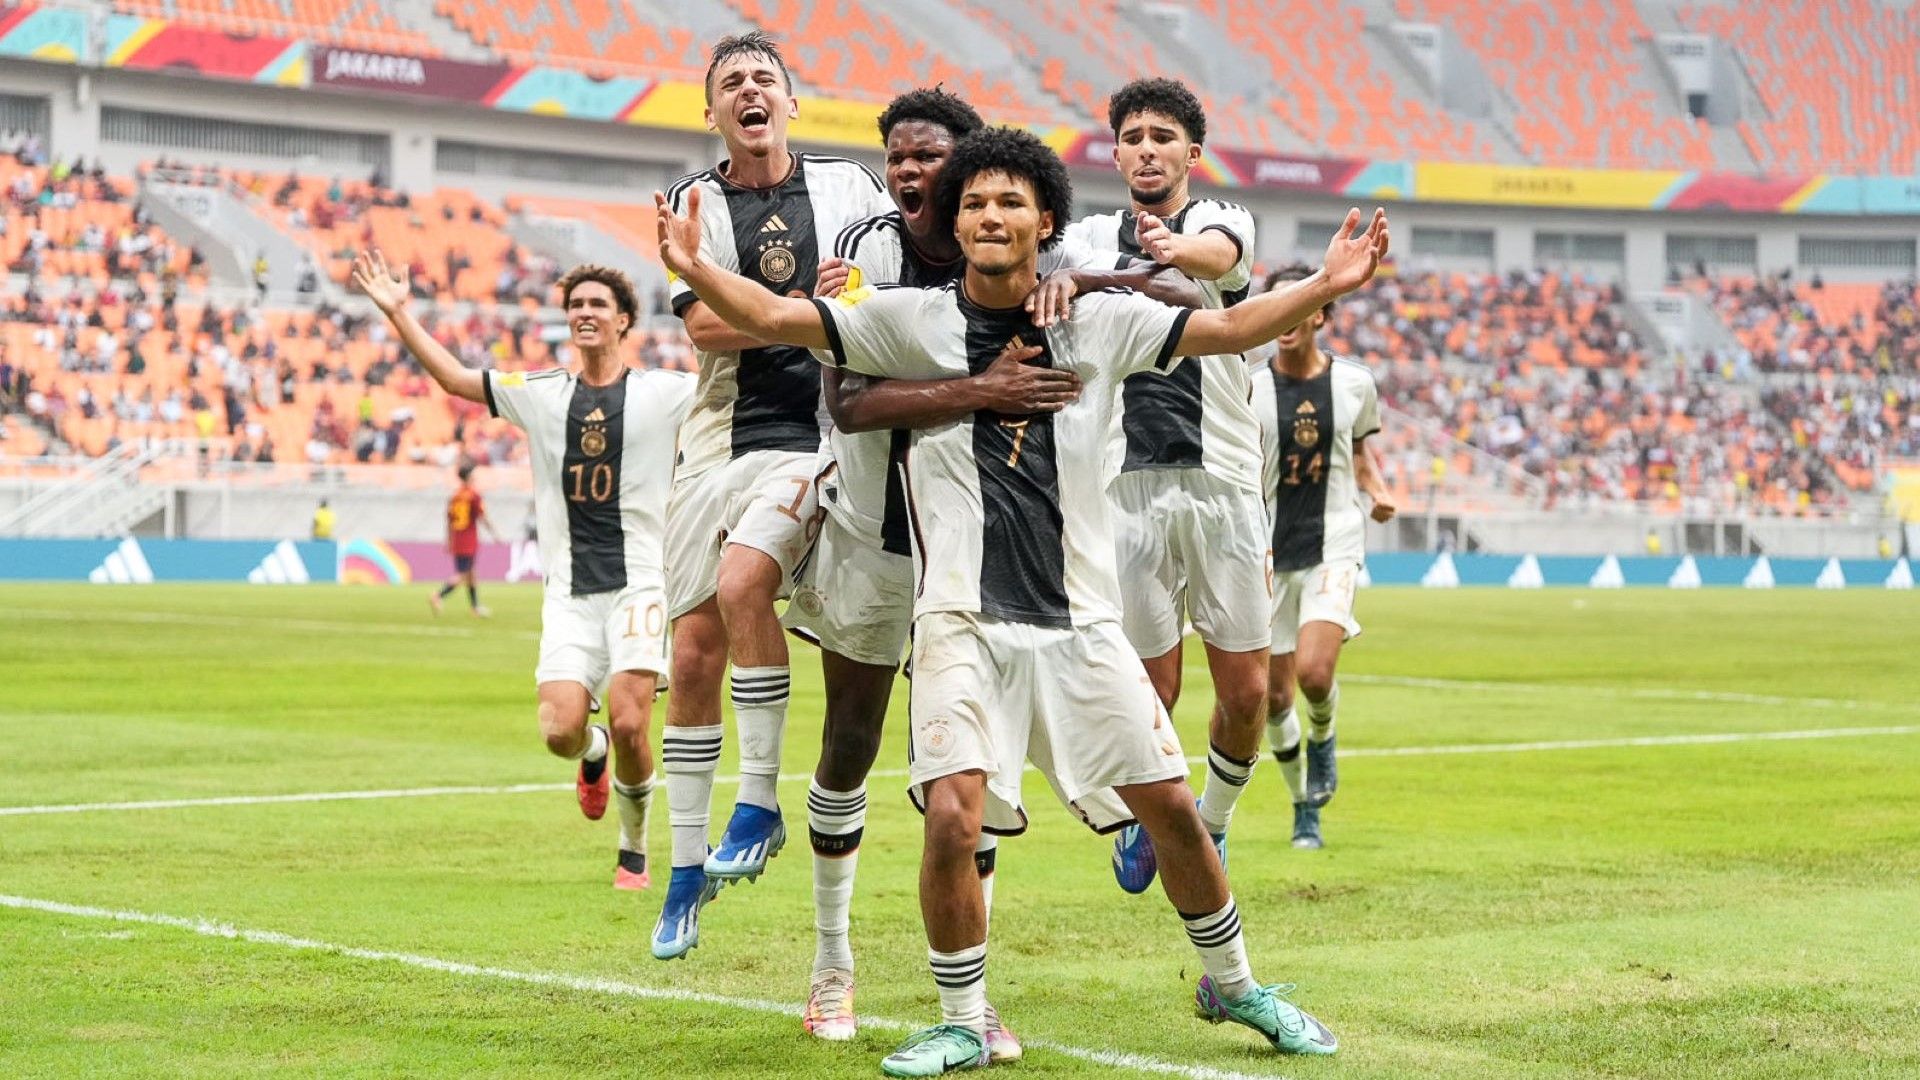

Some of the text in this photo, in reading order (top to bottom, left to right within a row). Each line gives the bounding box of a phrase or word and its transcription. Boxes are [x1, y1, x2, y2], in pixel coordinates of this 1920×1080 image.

[325, 49, 426, 85] JAKARTA
[569, 463, 613, 501] 10
[1284, 453, 1323, 486] 14
[621, 603, 666, 639] 10
